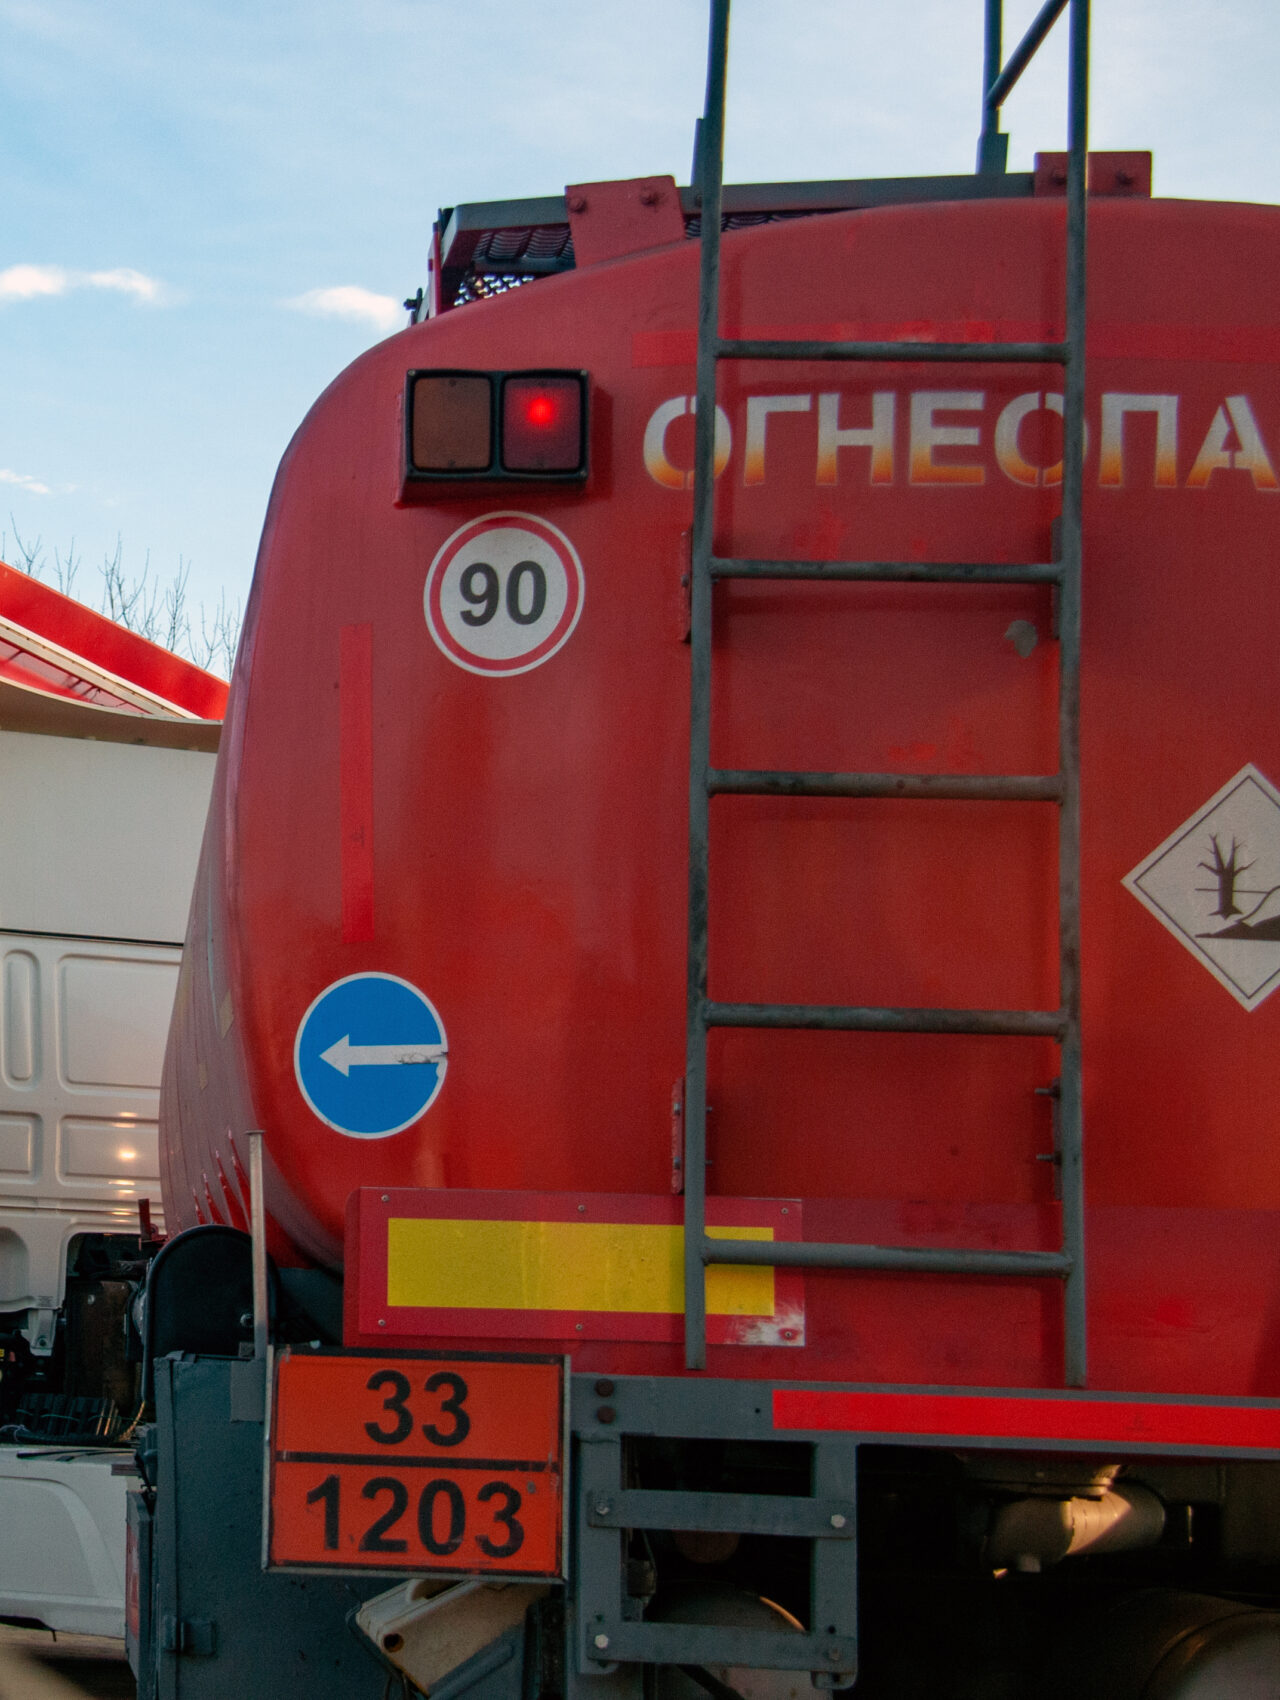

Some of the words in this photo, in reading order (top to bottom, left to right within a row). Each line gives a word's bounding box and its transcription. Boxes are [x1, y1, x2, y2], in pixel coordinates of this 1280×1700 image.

[459, 560, 547, 627] 90
[364, 1369, 471, 1447] 33
[306, 1474, 525, 1558] 1203
